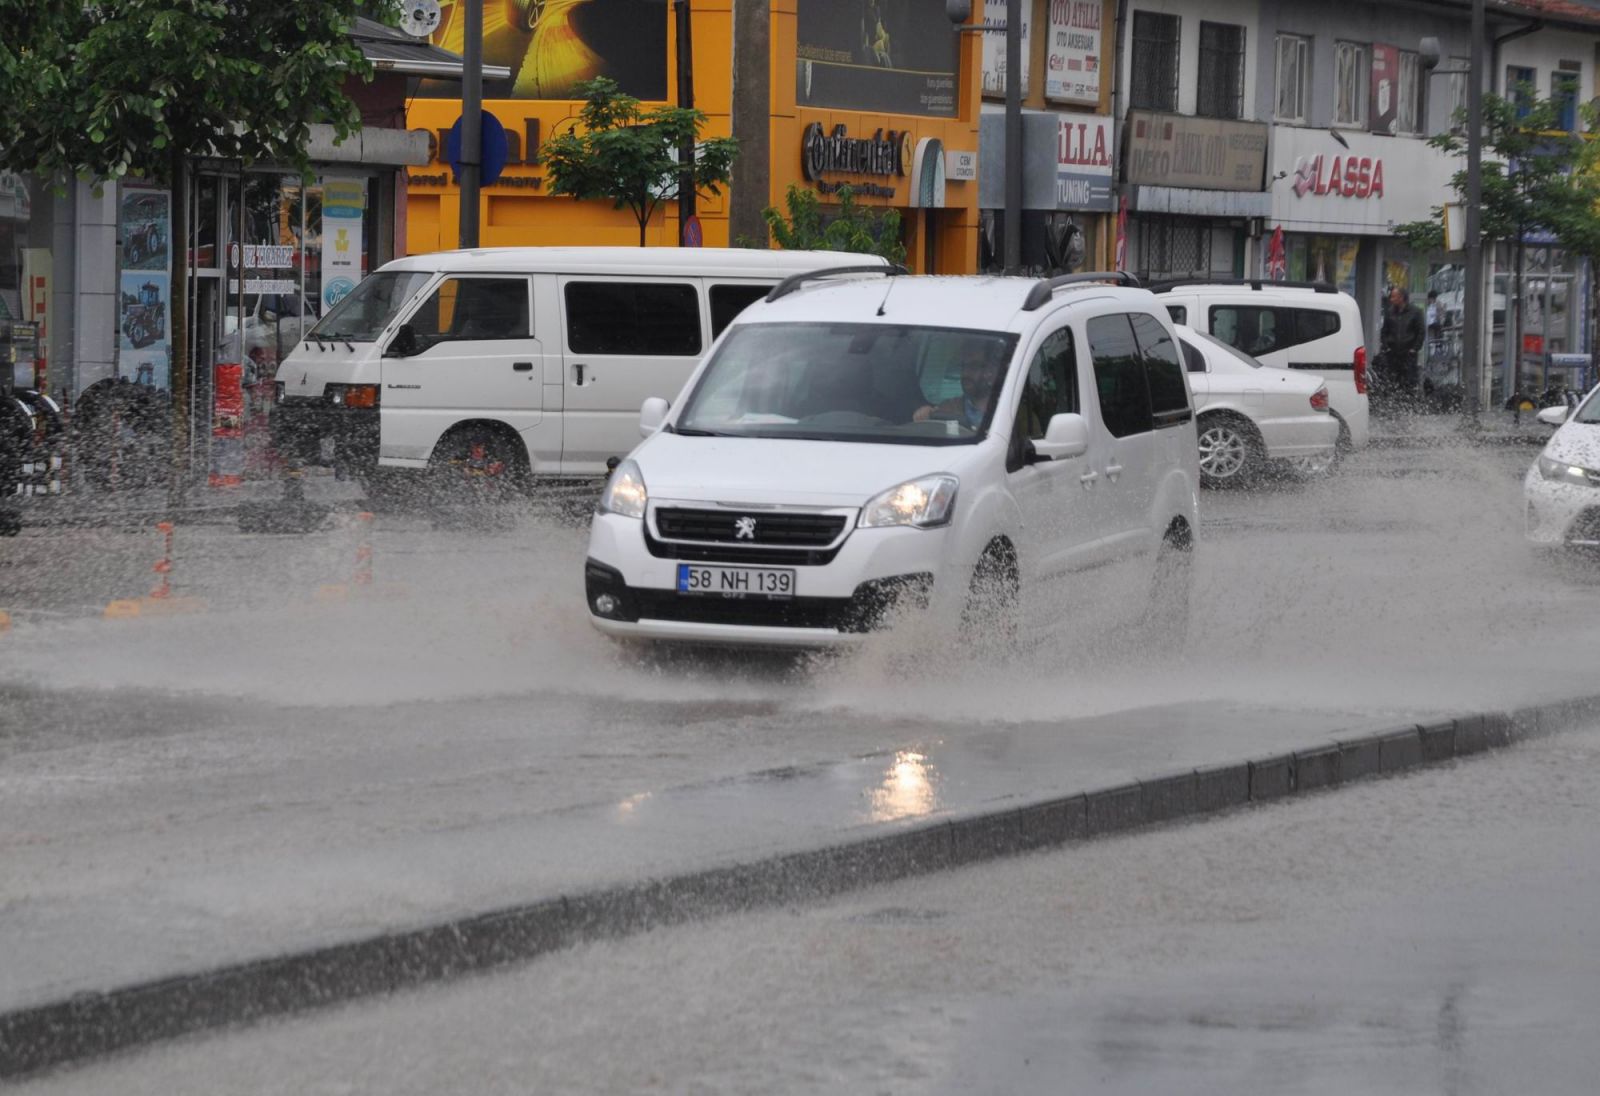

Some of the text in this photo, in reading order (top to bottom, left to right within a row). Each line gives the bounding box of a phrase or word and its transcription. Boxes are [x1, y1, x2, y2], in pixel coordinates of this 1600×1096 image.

[1051, 0, 1071, 25] OTO
[1056, 31, 1068, 47] OTO
[1314, 155, 1385, 199] LASSA
[689, 569, 790, 592] 58 NH 139
